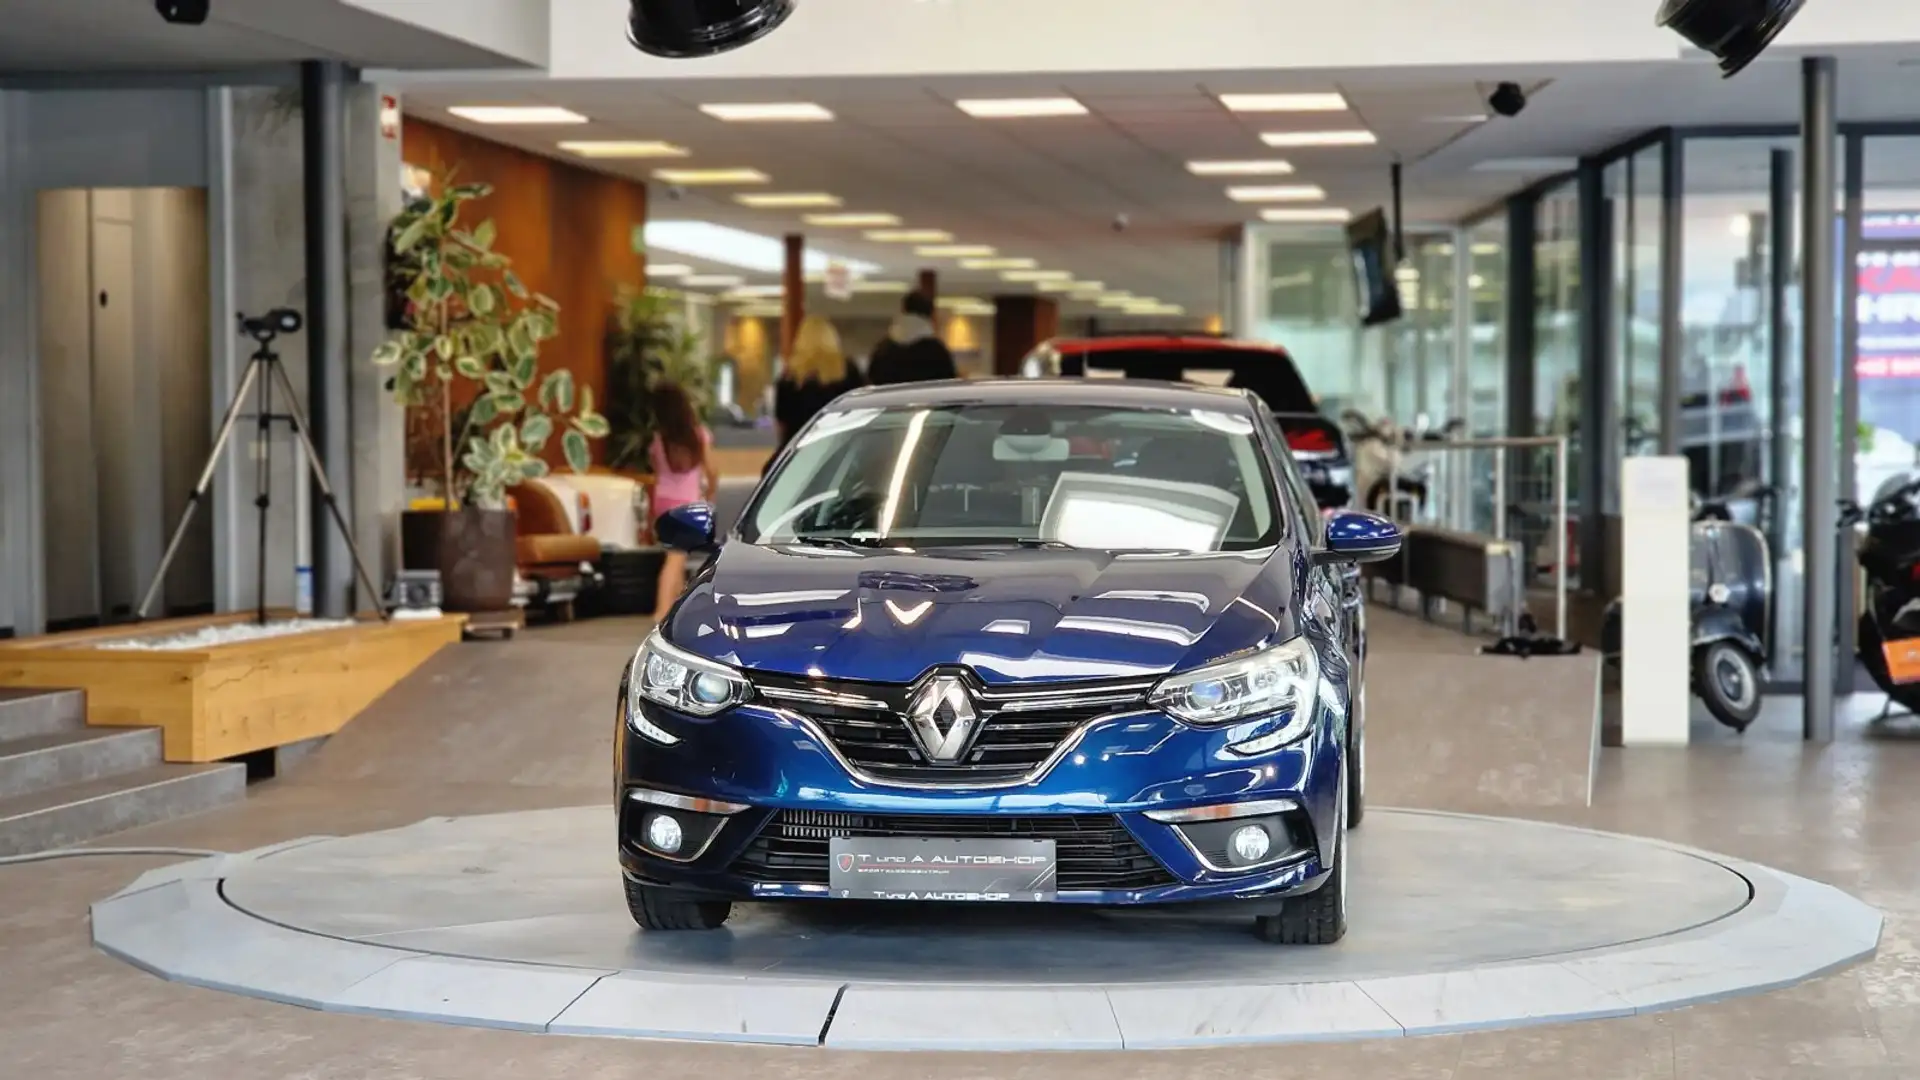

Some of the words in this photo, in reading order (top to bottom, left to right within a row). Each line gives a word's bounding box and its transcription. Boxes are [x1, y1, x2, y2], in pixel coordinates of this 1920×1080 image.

[858, 854, 871, 862] T
[910, 855, 924, 863] A
[931, 855, 1047, 864] AUTOSHOP
[924, 892, 1010, 901] AUTOSHOP
